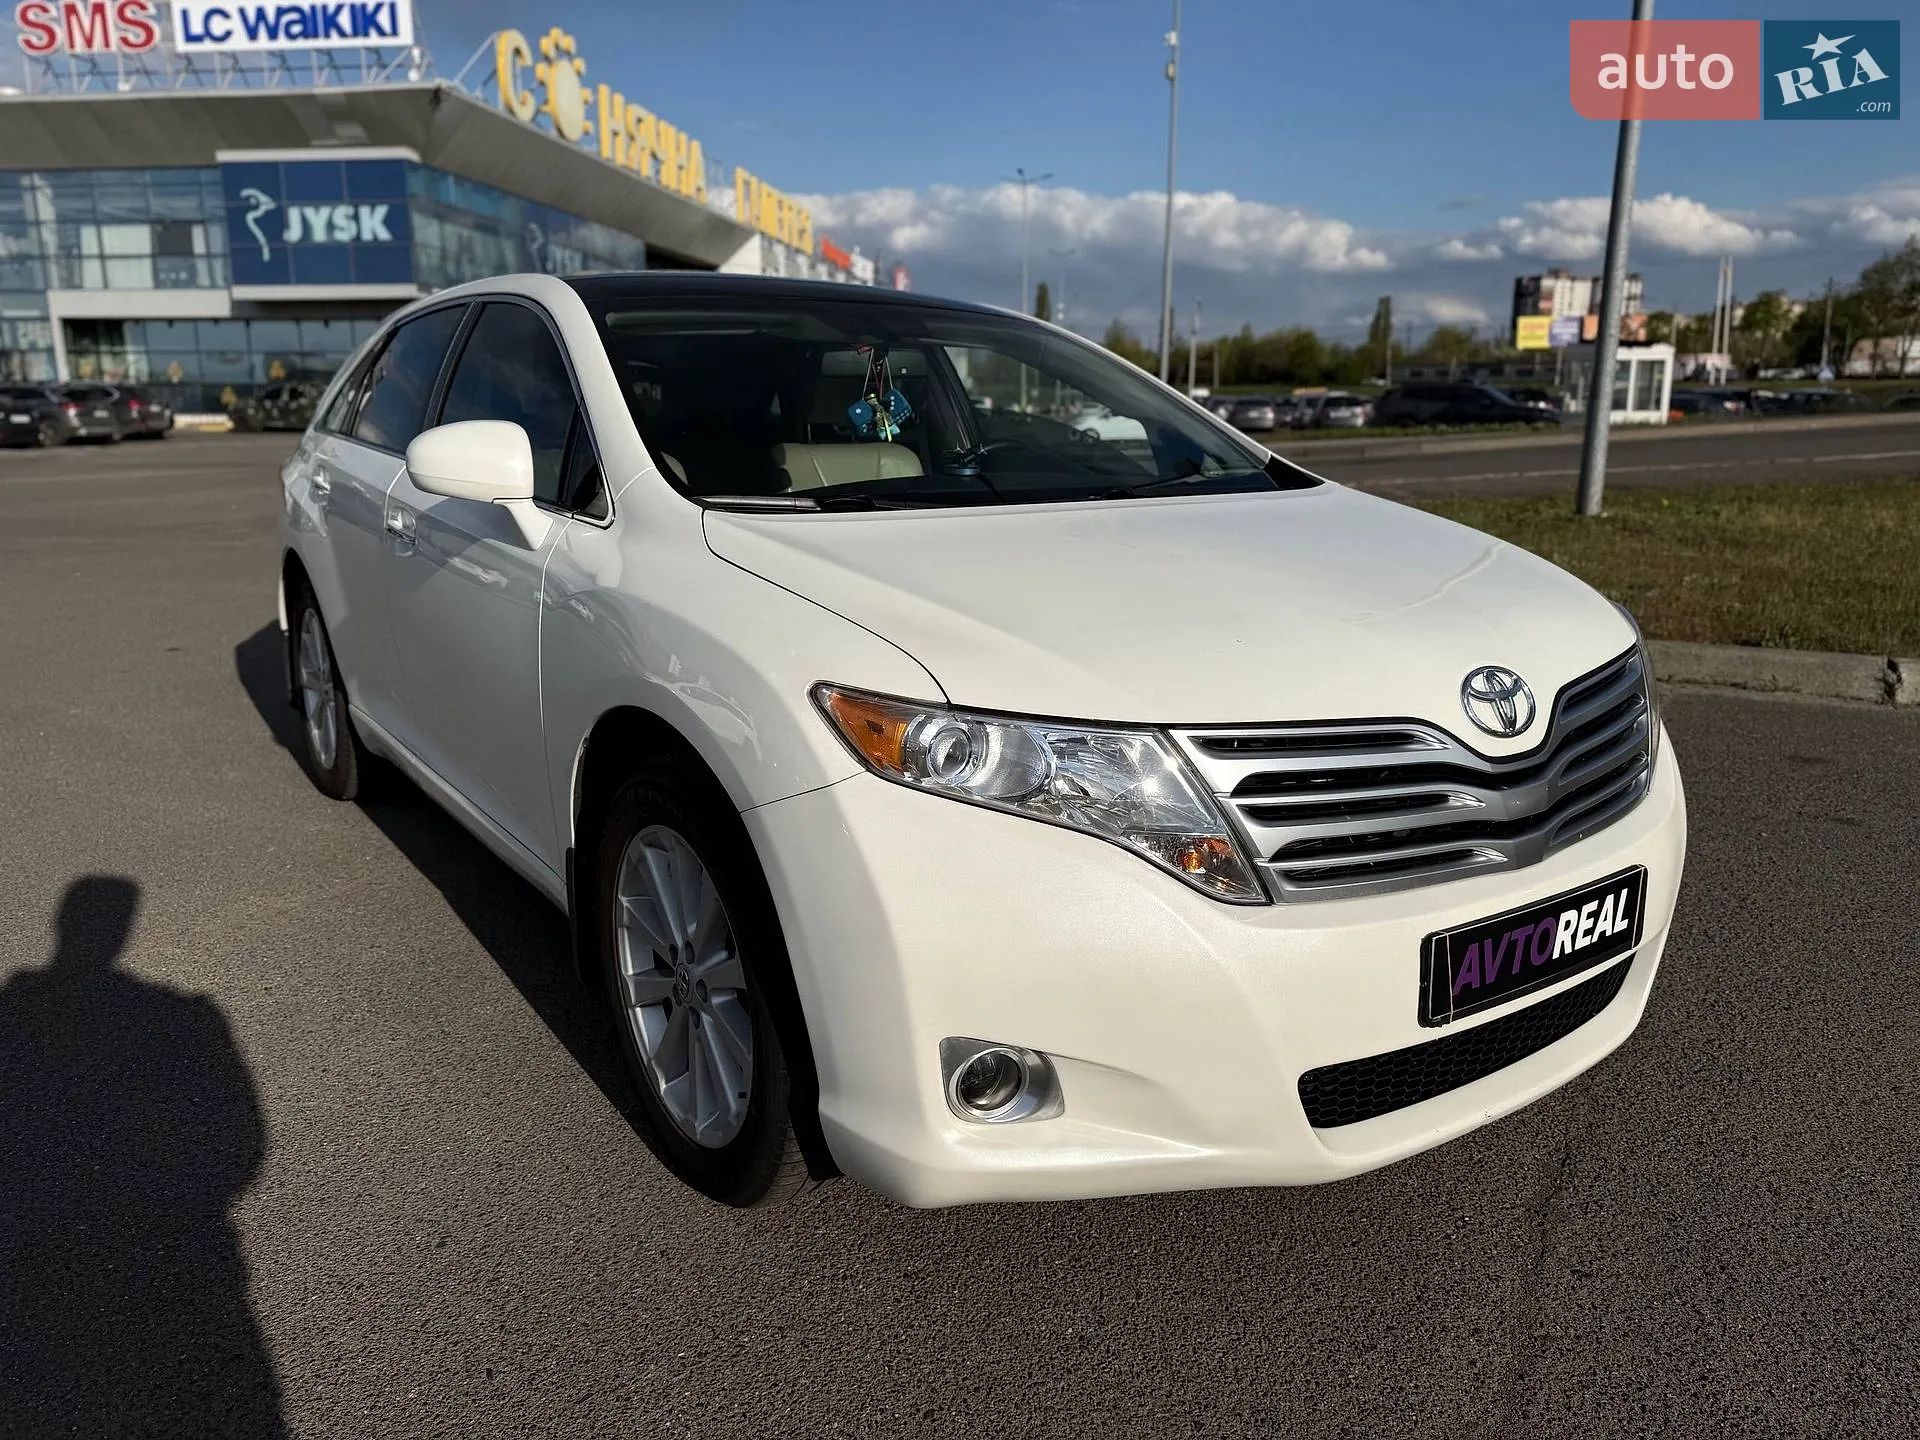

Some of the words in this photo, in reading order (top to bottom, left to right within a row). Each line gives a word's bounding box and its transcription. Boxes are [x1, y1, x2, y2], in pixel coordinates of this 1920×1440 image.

[17, 0, 158, 52] SMS
[181, 8, 234, 43] LC
[282, 203, 394, 243] JYSK
[1452, 888, 1629, 998] AVTOREAL
